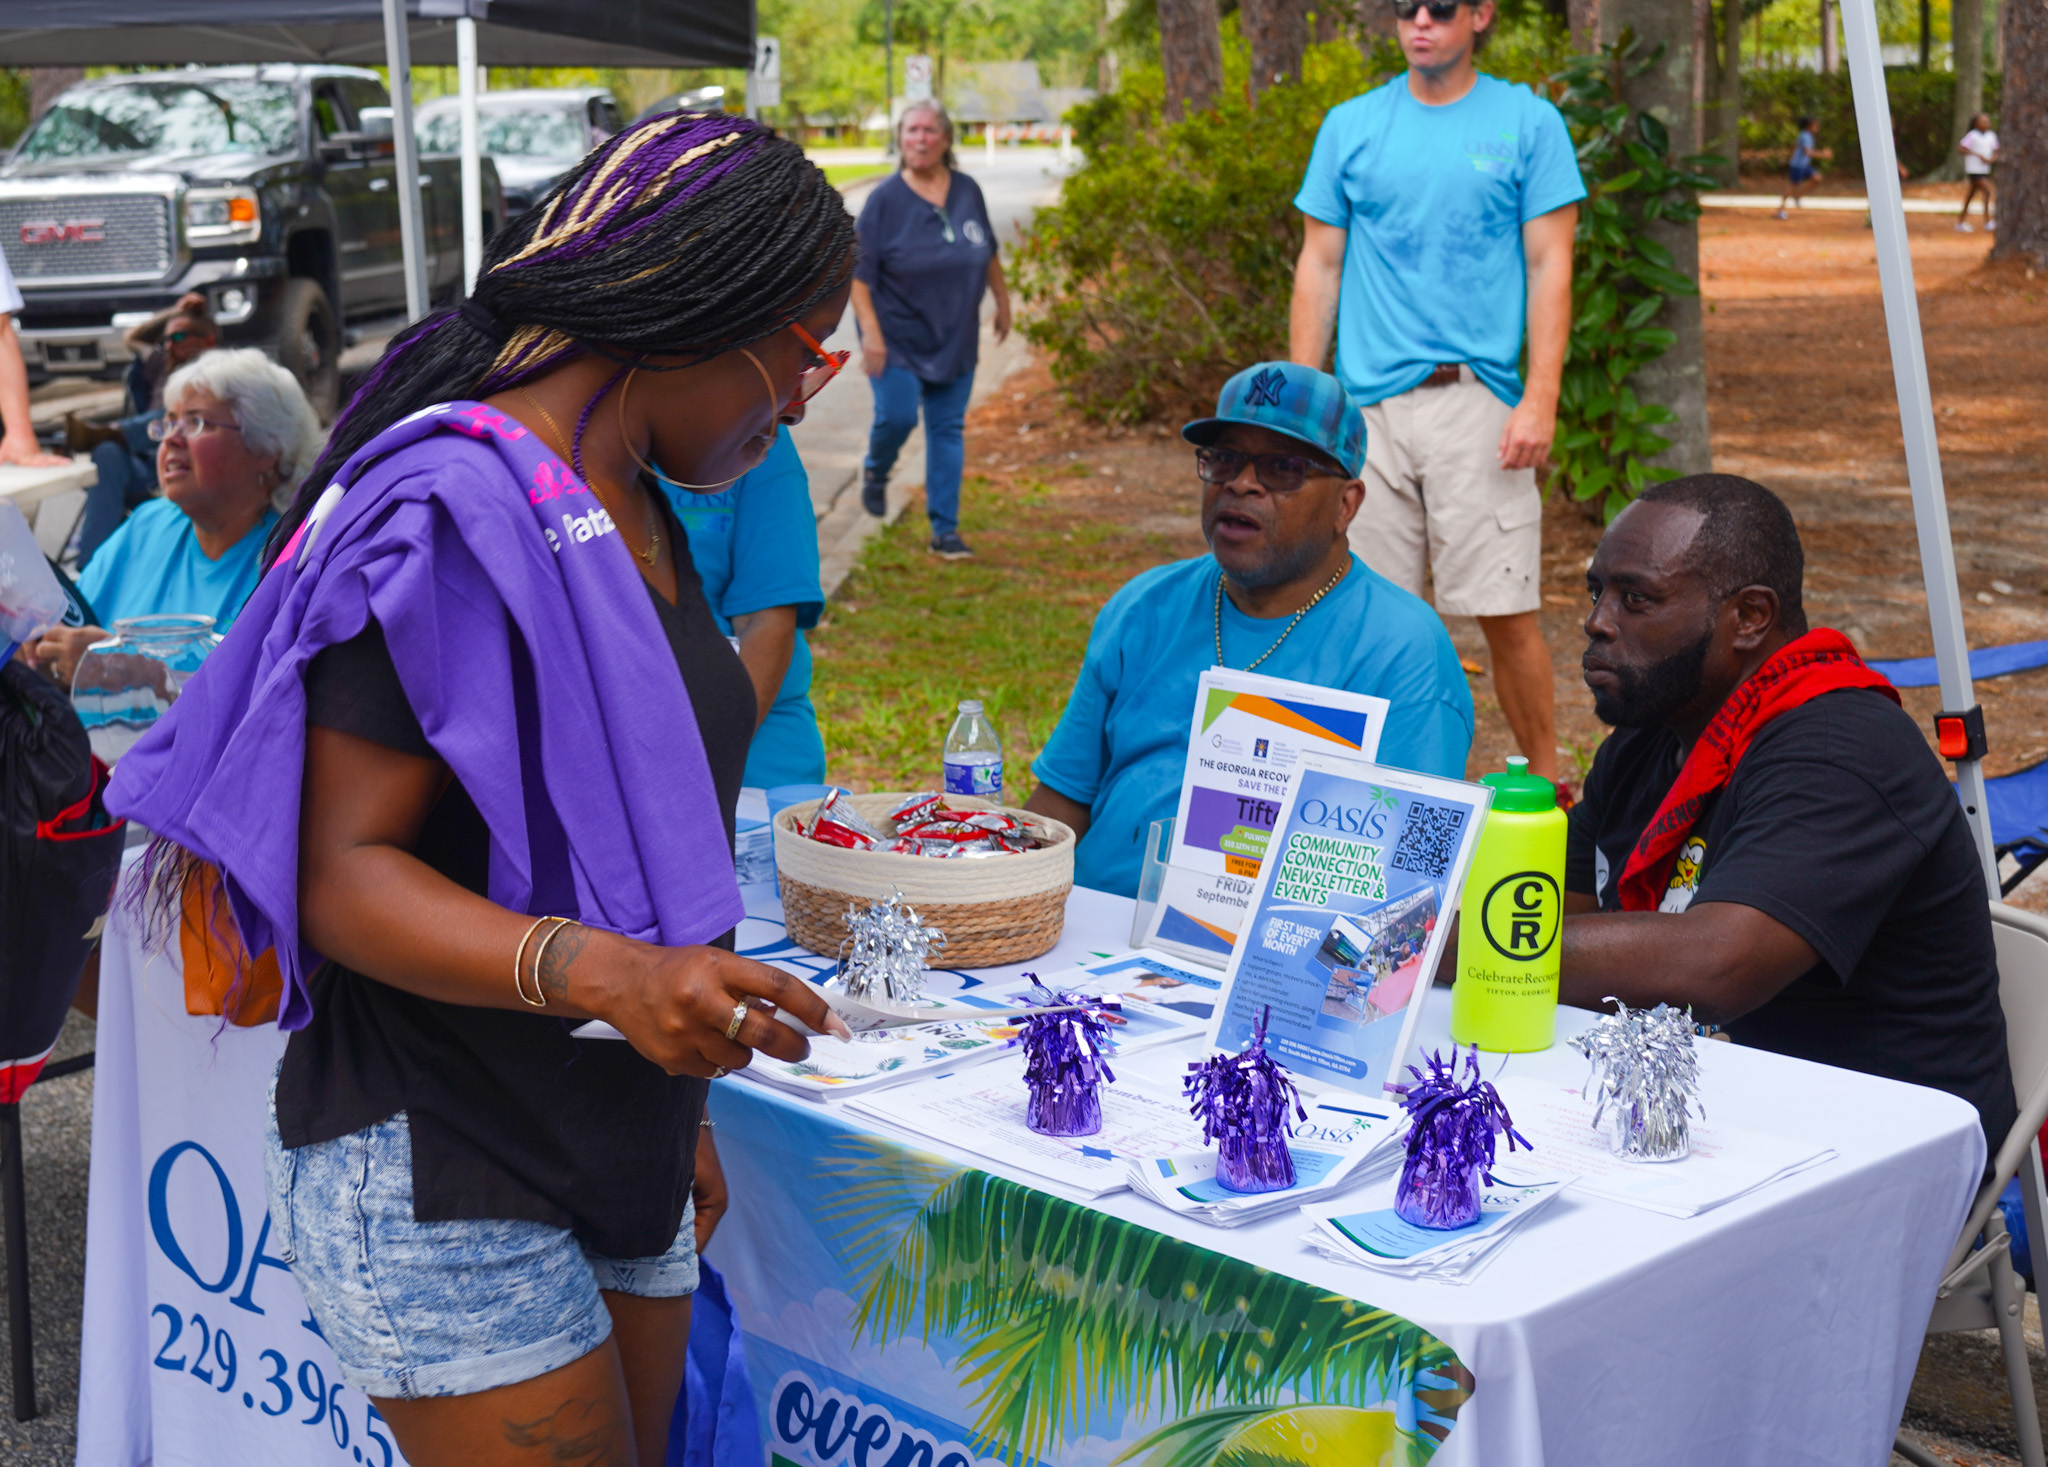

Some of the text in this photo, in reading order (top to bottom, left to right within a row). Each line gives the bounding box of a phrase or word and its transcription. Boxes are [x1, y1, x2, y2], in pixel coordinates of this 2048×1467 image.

[21, 220, 105, 243] GMC
[1200, 758, 1291, 783] THE GEORGIA RECOV
[1238, 778, 1261, 791] SAVE
[1264, 783, 1279, 796] THE
[1300, 799, 1387, 839] OASIS
[1290, 834, 1380, 862] COMMUNITY
[1285, 850, 1383, 881] CONNECTION,
[1274, 881, 1328, 905] EVENTS
[1280, 865, 1385, 899] NEWSLETTER &
[1266, 928, 1311, 948] OF EVERY
[1270, 917, 1322, 940] FIRST WEEK
[1262, 938, 1297, 956] MONTH
[1295, 1124, 1359, 1144] OASIS
